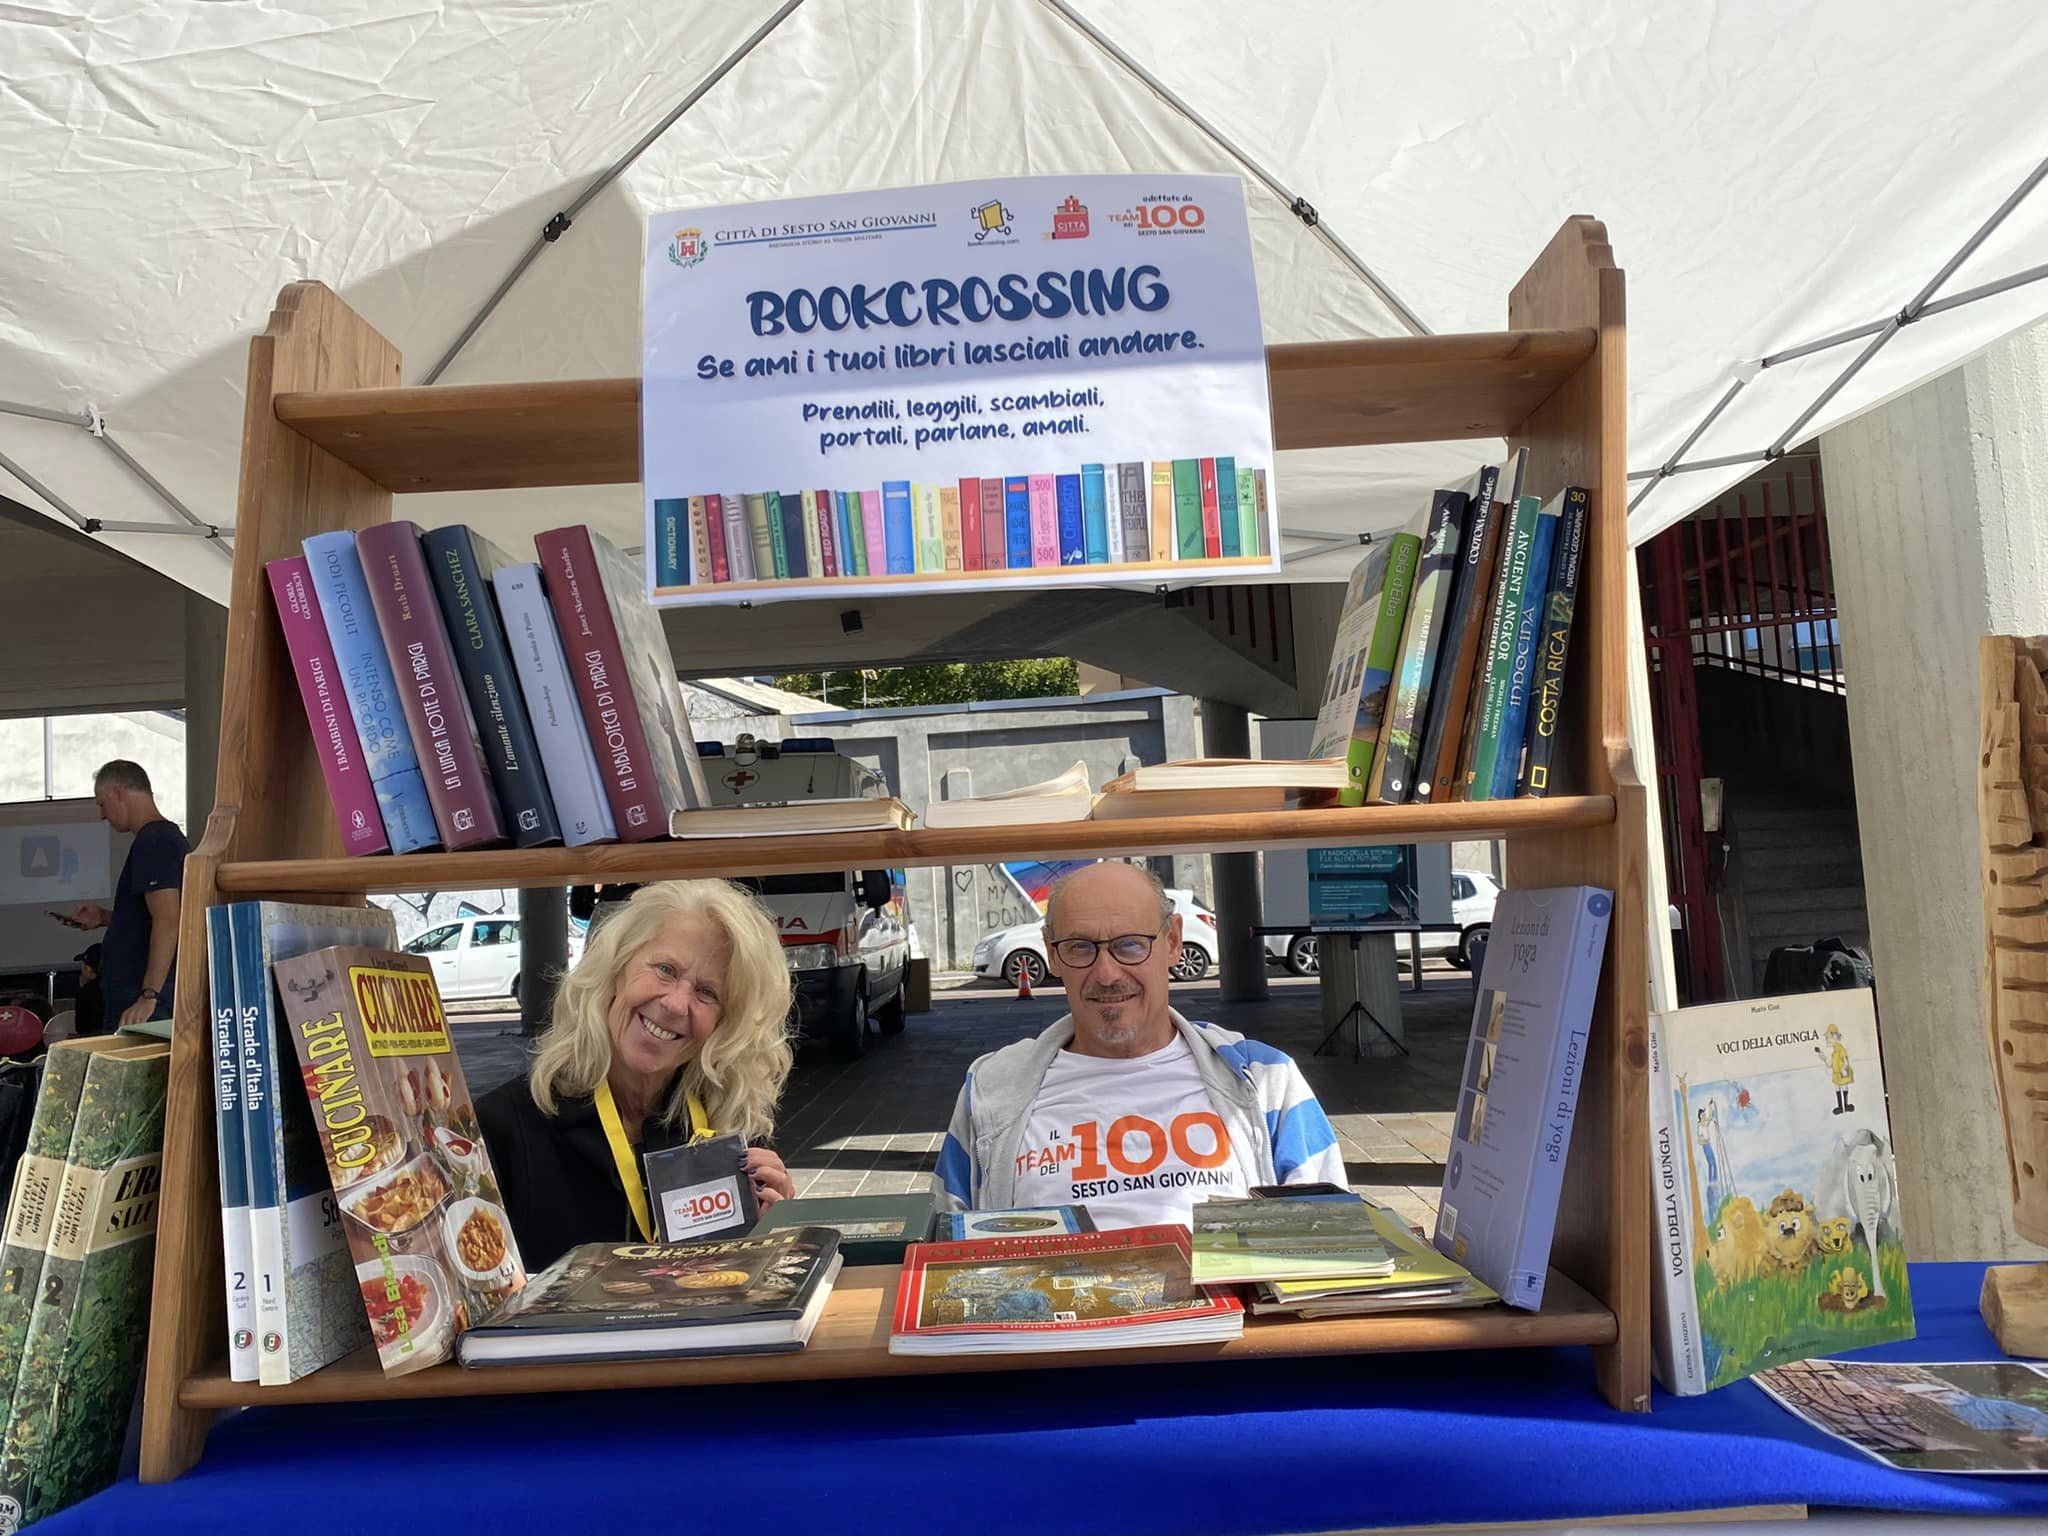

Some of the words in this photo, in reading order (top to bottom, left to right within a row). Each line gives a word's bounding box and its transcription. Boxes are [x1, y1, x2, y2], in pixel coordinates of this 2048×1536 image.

[782, 223, 825, 236] SESTO
[830, 219, 857, 230] SAN
[862, 212, 937, 228] GIOVANNI
[1108, 214, 1139, 223] TEAM
[1136, 204, 1205, 229] 100
[745, 264, 1170, 337] BOOKCROSSING
[697, 354, 735, 380] Se
[744, 350, 799, 377] ami
[807, 349, 815, 373] i
[824, 345, 886, 372] tuoi
[895, 341, 956, 369] libri
[964, 334, 1069, 366] lasciali
[1079, 330, 1205, 358] andare.
[803, 400, 900, 421] Prendili,
[907, 395, 983, 422] leggili,
[990, 387, 1105, 412] scambiali,
[820, 426, 908, 454] portali,
[915, 421, 1015, 450] parlane,
[1023, 415, 1090, 438] amali.
[1035, 480, 1050, 491] 500
[1570, 491, 1586, 503] 30
[667, 516, 678, 570] DICTIONARY
[1468, 519, 1486, 565] CORTONA
[1571, 508, 1585, 553] GEOGRAPHIC
[562, 547, 575, 579] Charles
[1037, 548, 1054, 561] 500
[1395, 542, 1414, 574] Isola
[1503, 531, 1515, 566] SAGRADA
[1509, 530, 1529, 595] ANCIENT
[1501, 567, 1510, 578] LA
[1566, 553, 1578, 588] NATIONAL
[286, 582, 299, 613] GLORIA
[324, 549, 341, 579] JODI
[334, 583, 359, 636] PICOULT
[398, 594, 412, 621] Ruth
[1386, 576, 1405, 617] d'Elba
[580, 612, 592, 637] Janet
[1495, 606, 1503, 616] DI
[464, 608, 485, 650] CLARA
[1488, 617, 1502, 650] EREDITÀ
[1497, 600, 1518, 661] ANGKOR
[408, 642, 431, 681] PARIGI
[585, 650, 609, 690] PARIGI
[1486, 651, 1497, 672] GRAN
[1509, 607, 1535, 706] INDOCINA
[309, 657, 329, 698] PARIGI
[418, 682, 436, 697] DI
[1484, 673, 1493, 683] LA
[1488, 677, 1497, 702] CLAUDE
[1496, 679, 1506, 708] MICHAEL
[1537, 674, 1559, 737] COSTA
[1548, 629, 1567, 672] RICA
[321, 698, 333, 713] DI
[348, 666, 362, 689] UN
[356, 692, 381, 754] RICORDO
[361, 652, 387, 713] INTENSO
[379, 717, 401, 760] COME
[484, 674, 506, 721] silenzioso
[597, 691, 615, 707] DI
[423, 698, 447, 738] NOTTE
[1491, 709, 1502, 738] FREEMAN
[325, 712, 348, 765] BAMBINI
[497, 720, 519, 771] L'amante
[601, 708, 633, 776] BIBLIOTECA
[434, 739, 457, 774] LUNGA
[444, 775, 462, 790] LA
[619, 777, 637, 792] LA
[987, 885, 1008, 904] MY
[1511, 916, 1539, 938] Lezioni
[1540, 917, 1551, 937] di
[1510, 943, 1538, 973] yoga
[357, 973, 443, 1034] CUCINARE
[1751, 1006, 1767, 1014] Mario
[218, 1008, 236, 1056] Strade
[243, 1007, 260, 1056] Strade
[1716, 1041, 1740, 1055] VOCI
[1742, 1036, 1773, 1051] DELLA
[1775, 1029, 1819, 1046] GIUNGLA
[1561, 1029, 1586, 1097] Lezioni
[1653, 1050, 1661, 1073] Mario
[220, 1060, 238, 1110] d'Italia
[246, 1059, 264, 1110] d'Italia
[300, 1011, 376, 1169] CUCINARE
[1556, 1102, 1574, 1120] di
[1015, 1142, 1076, 1177] TEAM
[1071, 1111, 1232, 1181] 100
[1049, 1130, 1061, 1141] IL
[1545, 1121, 1566, 1164] yoga
[1040, 1163, 1060, 1176] DEI
[1658, 1126, 1674, 1190] GIUNGLA
[1071, 1180, 1119, 1199] SESTO
[1123, 1175, 1155, 1192] SAN
[1158, 1169, 1233, 1188] GIOVANNI
[674, 1207, 692, 1216] TEAM
[689, 1191, 732, 1217] 100
[1664, 1193, 1680, 1238] DELLA
[372, 1232, 401, 1303] Biondi
[1668, 1242, 1684, 1278] VOCI
[42, 1274, 64, 1306] 2
[233, 1271, 246, 1290] 2
[263, 1274, 271, 1292] 1
[399, 1306, 415, 1354] Lisa
